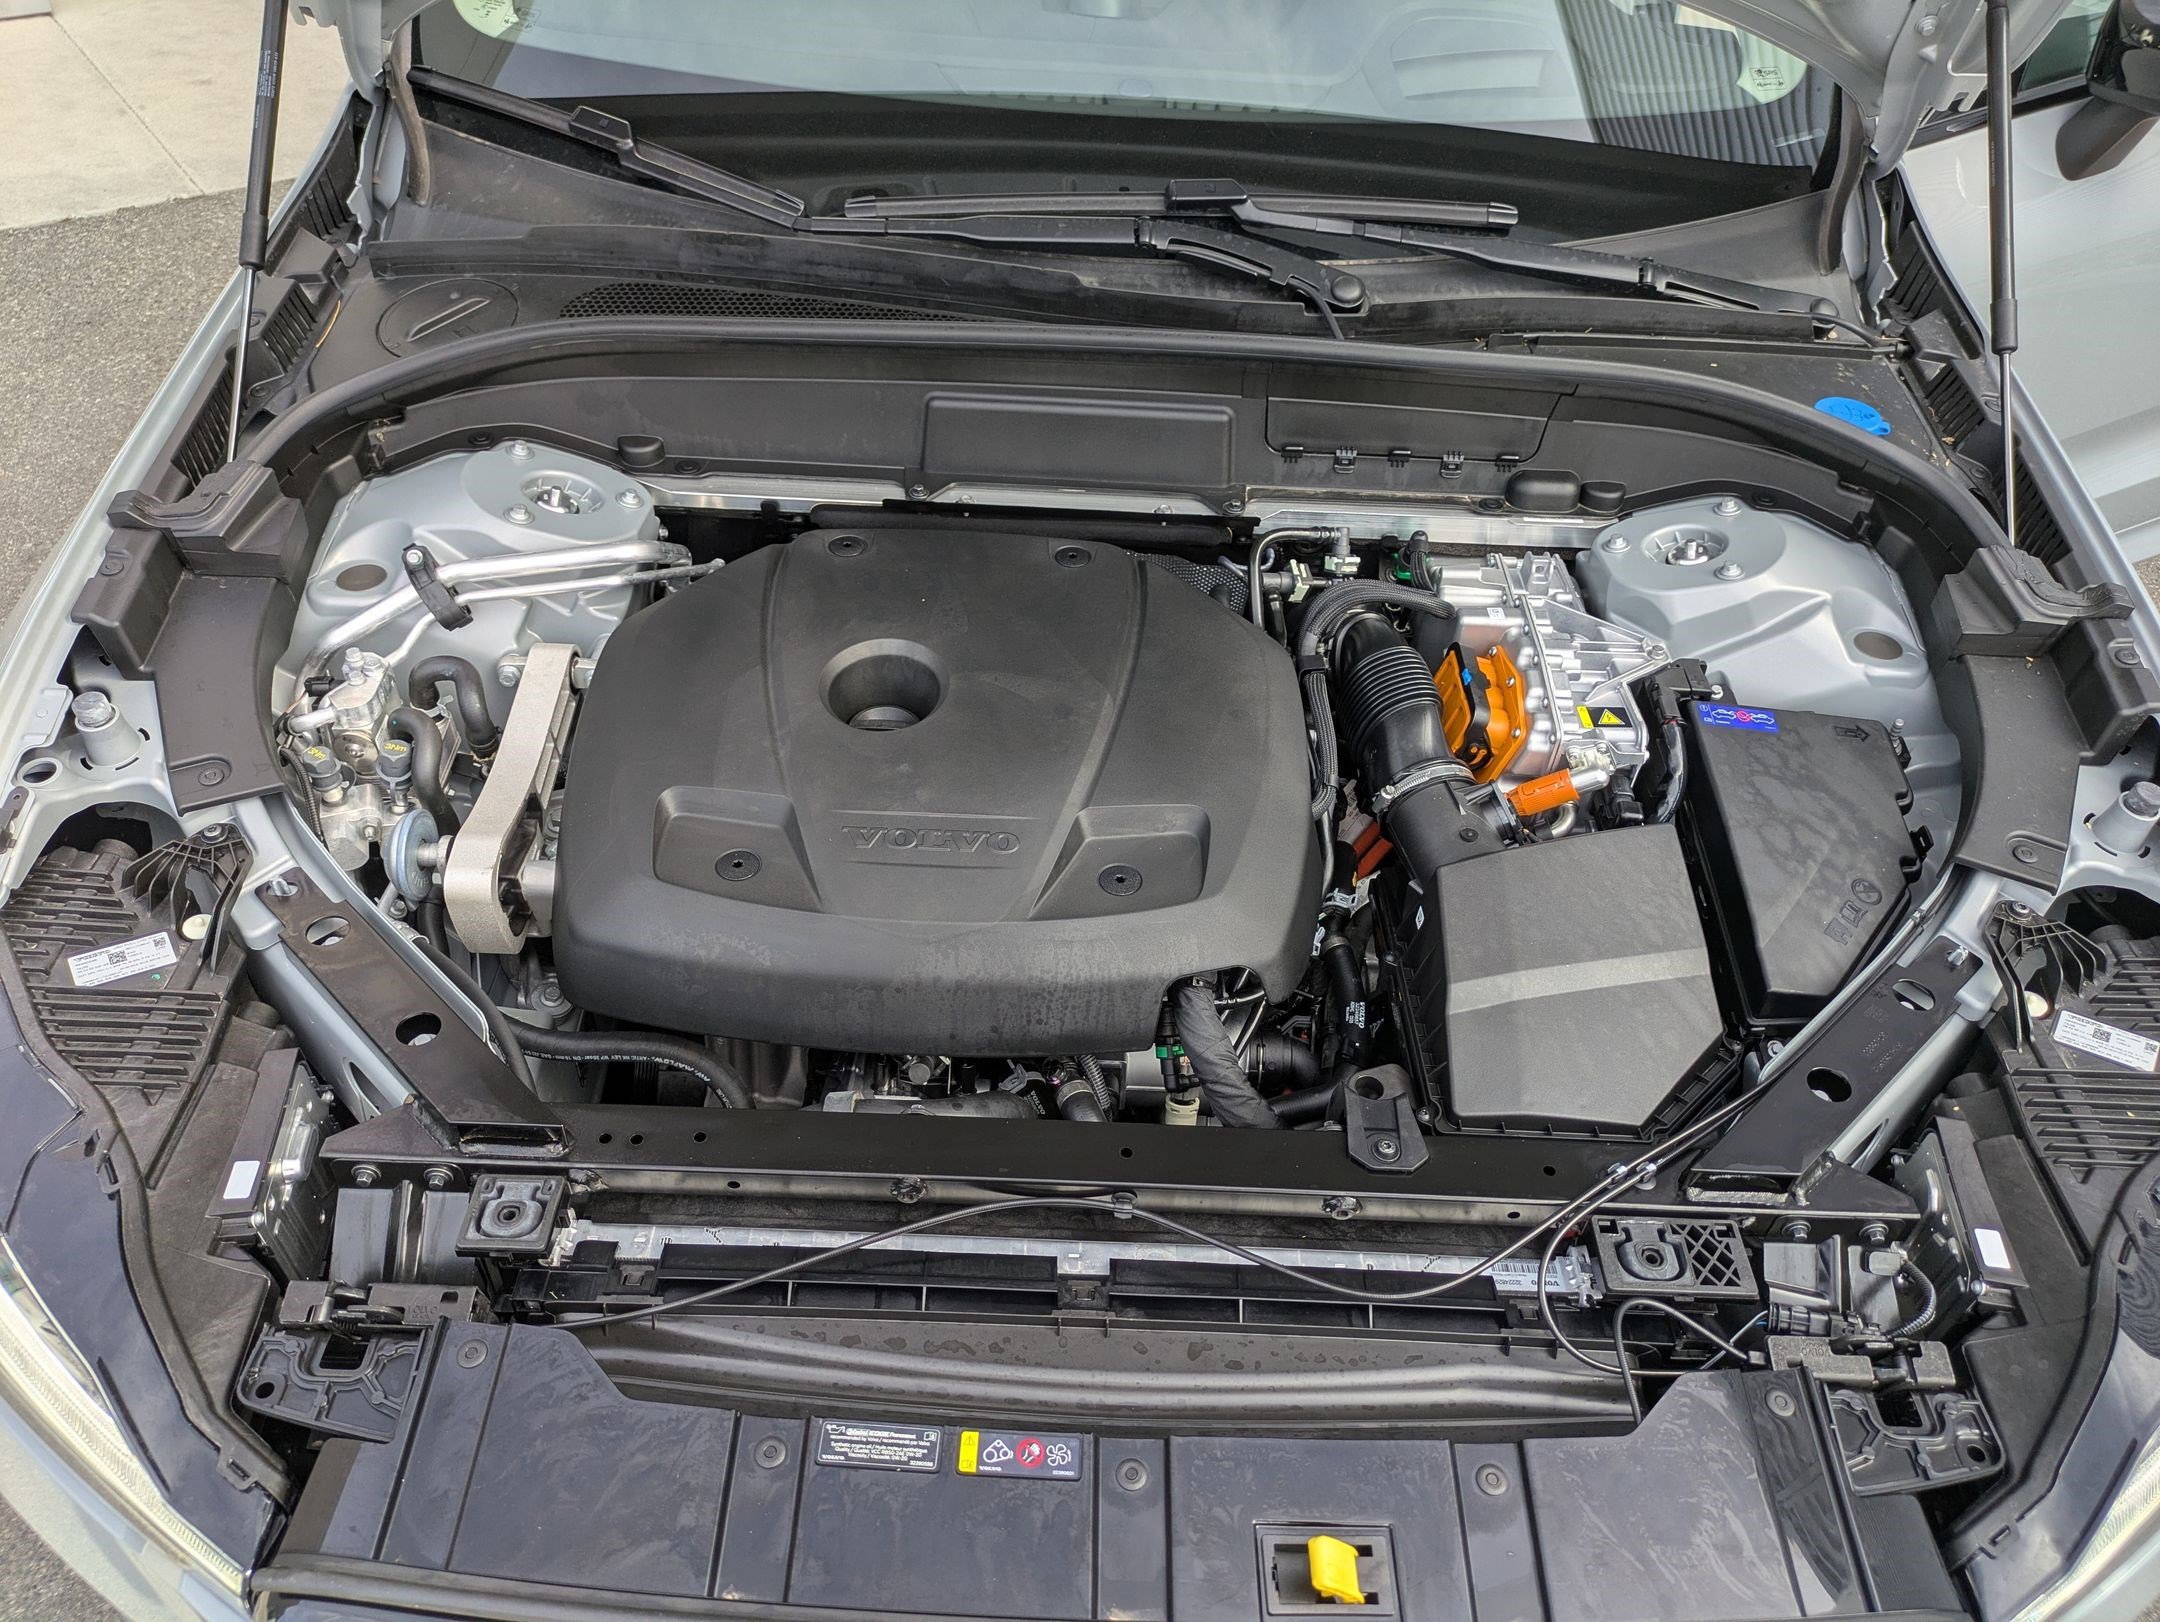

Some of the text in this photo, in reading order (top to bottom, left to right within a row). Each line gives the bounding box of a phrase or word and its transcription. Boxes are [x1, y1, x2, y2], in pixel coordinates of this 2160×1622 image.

[307, 747, 326, 760] 3Nm
[384, 742, 407, 752] 3Nm
[841, 826, 1021, 855] VOLVO
[1031, 1090, 1046, 1115] VOLVO
[1531, 1279, 1560, 1287] VOO
